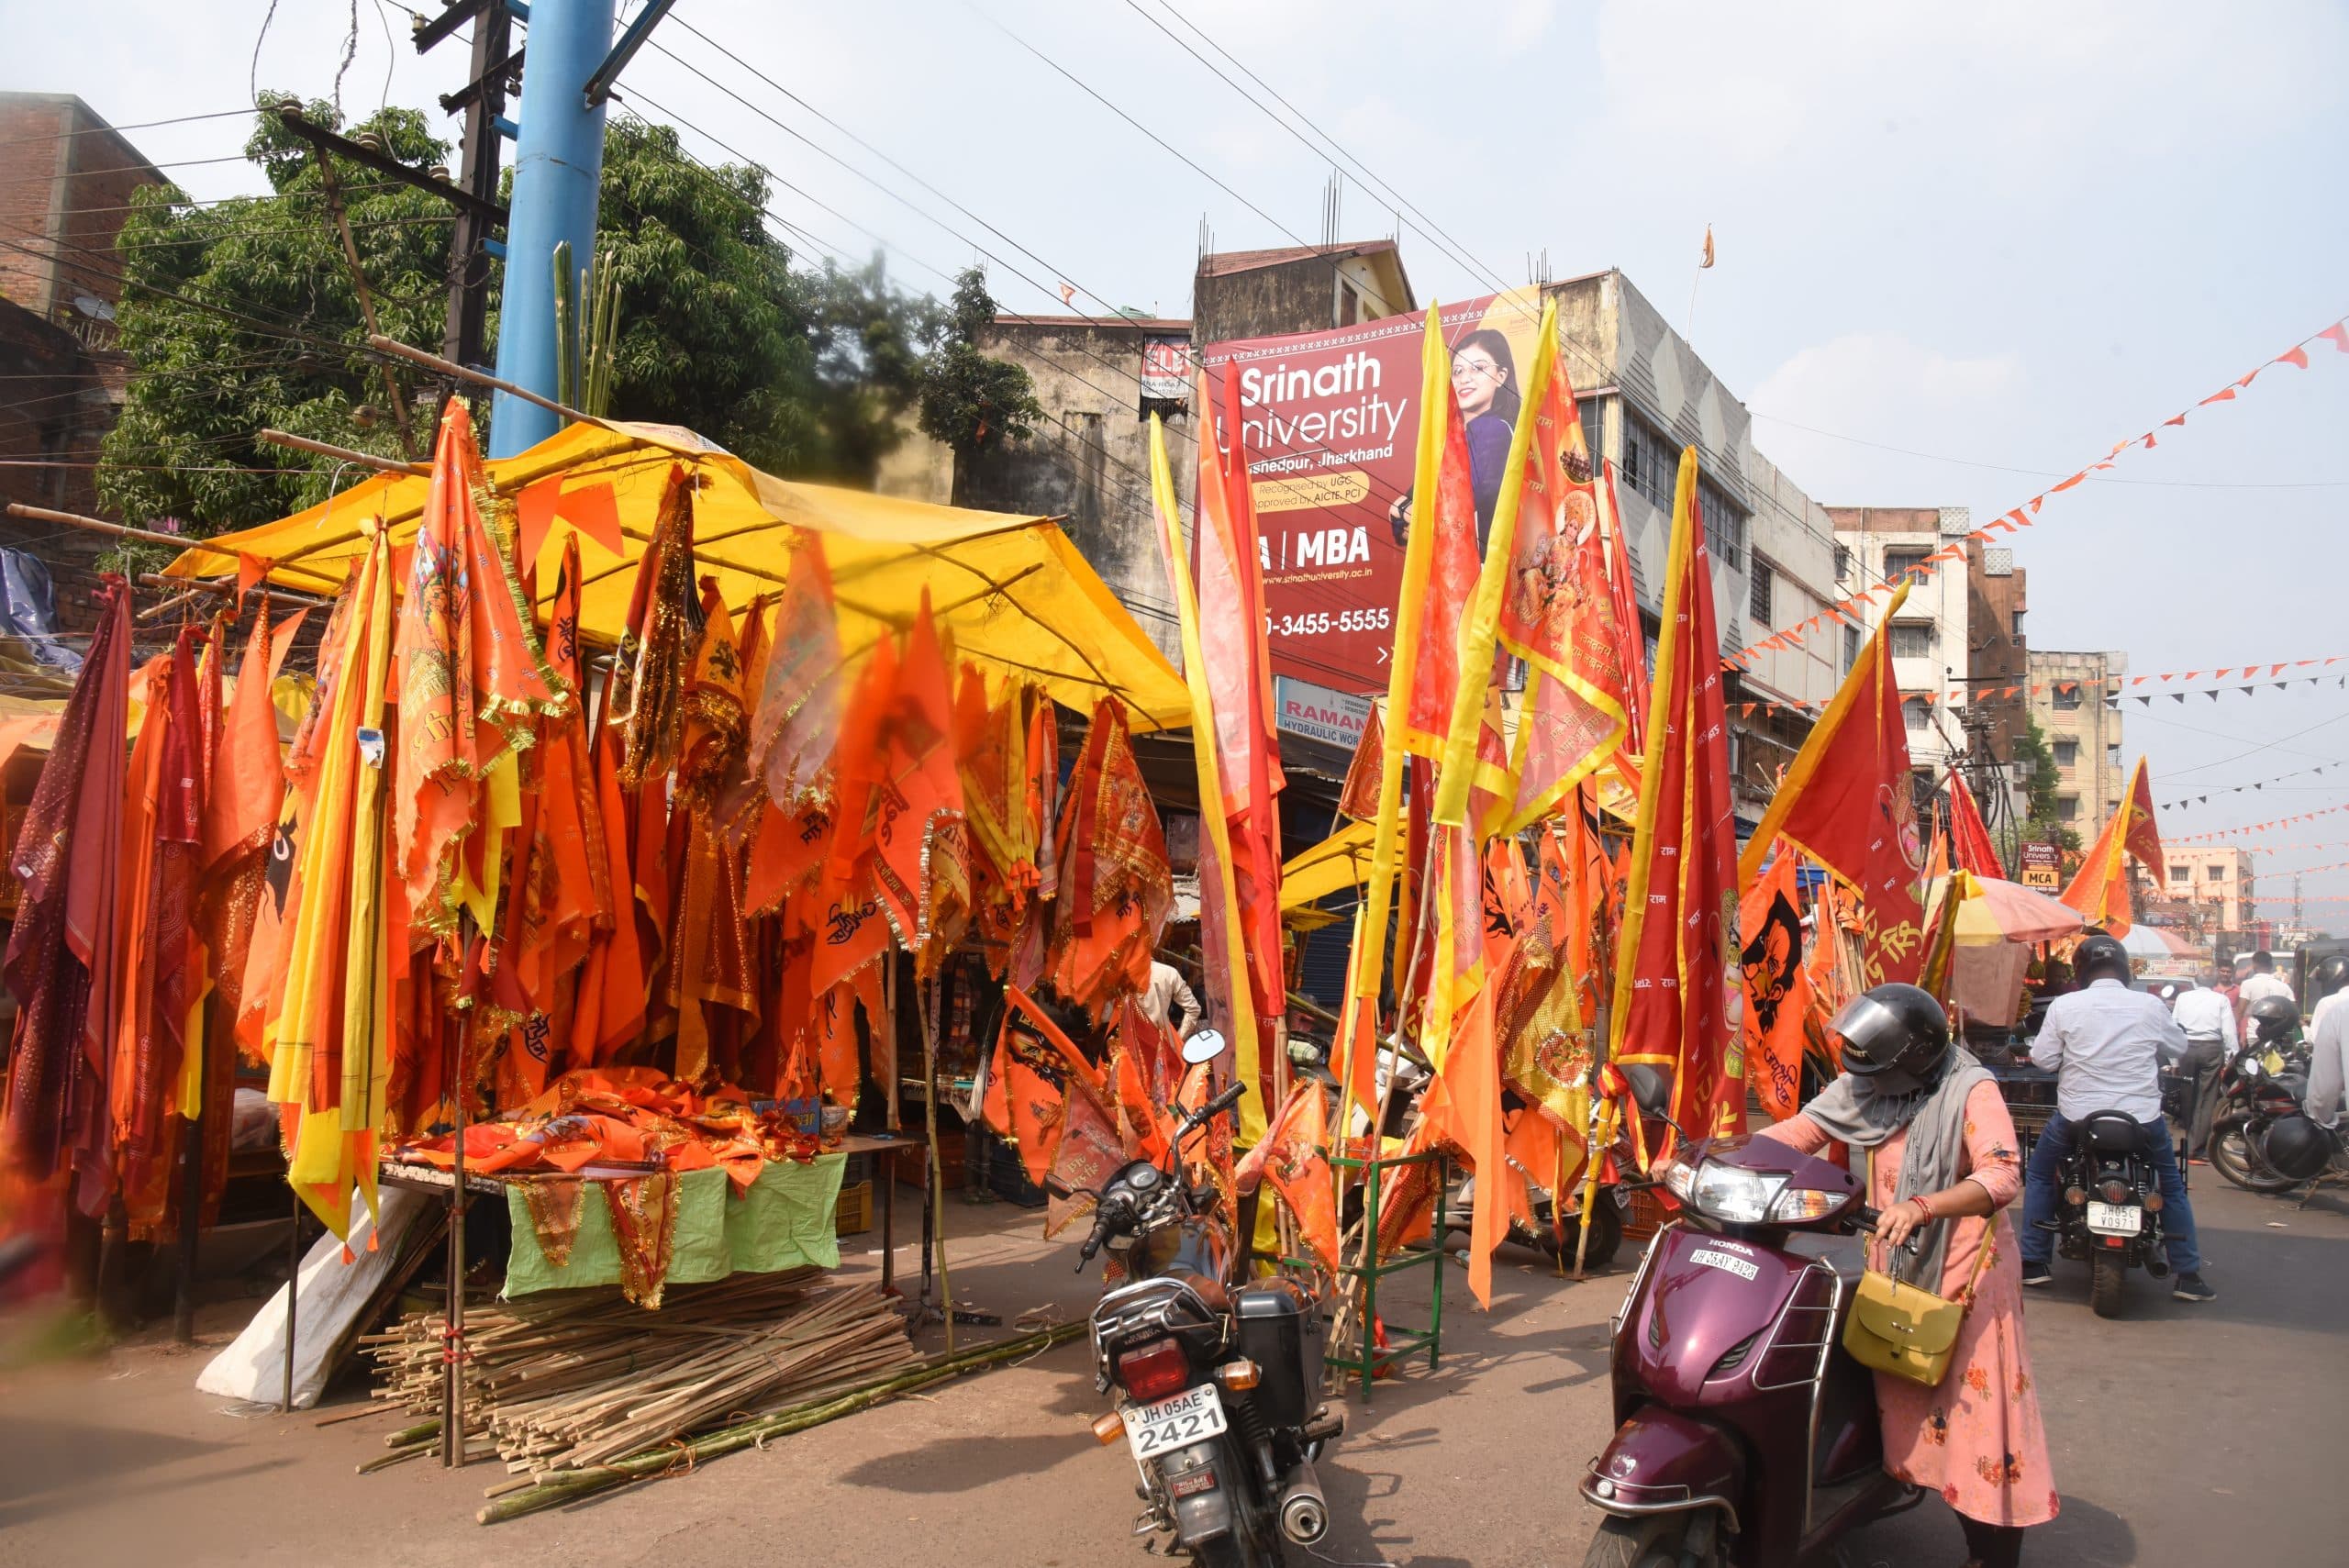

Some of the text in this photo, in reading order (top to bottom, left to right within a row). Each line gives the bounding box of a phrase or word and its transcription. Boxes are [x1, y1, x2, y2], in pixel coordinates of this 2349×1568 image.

[1241, 350, 1381, 406] Srinath
[1216, 393, 1408, 454] University
[1318, 443, 1393, 468] Jharkhand
[1259, 480, 1314, 495] Recognised
[1330, 475, 1353, 487] UGC
[1345, 488, 1361, 499] PCI
[1297, 526, 1371, 568] MBA
[1284, 719, 1359, 746] HYDRAULIC WOR
[2028, 844, 2054, 853] Srinath
[2029, 873, 2052, 884] MCA
[2101, 1217, 2134, 1229] V0971
[1692, 1251, 1707, 1262] JH
[1709, 1239, 1754, 1257] HONDA
[1142, 1392, 1203, 1424] JH 05AE
[1138, 1407, 1220, 1453] 2421
